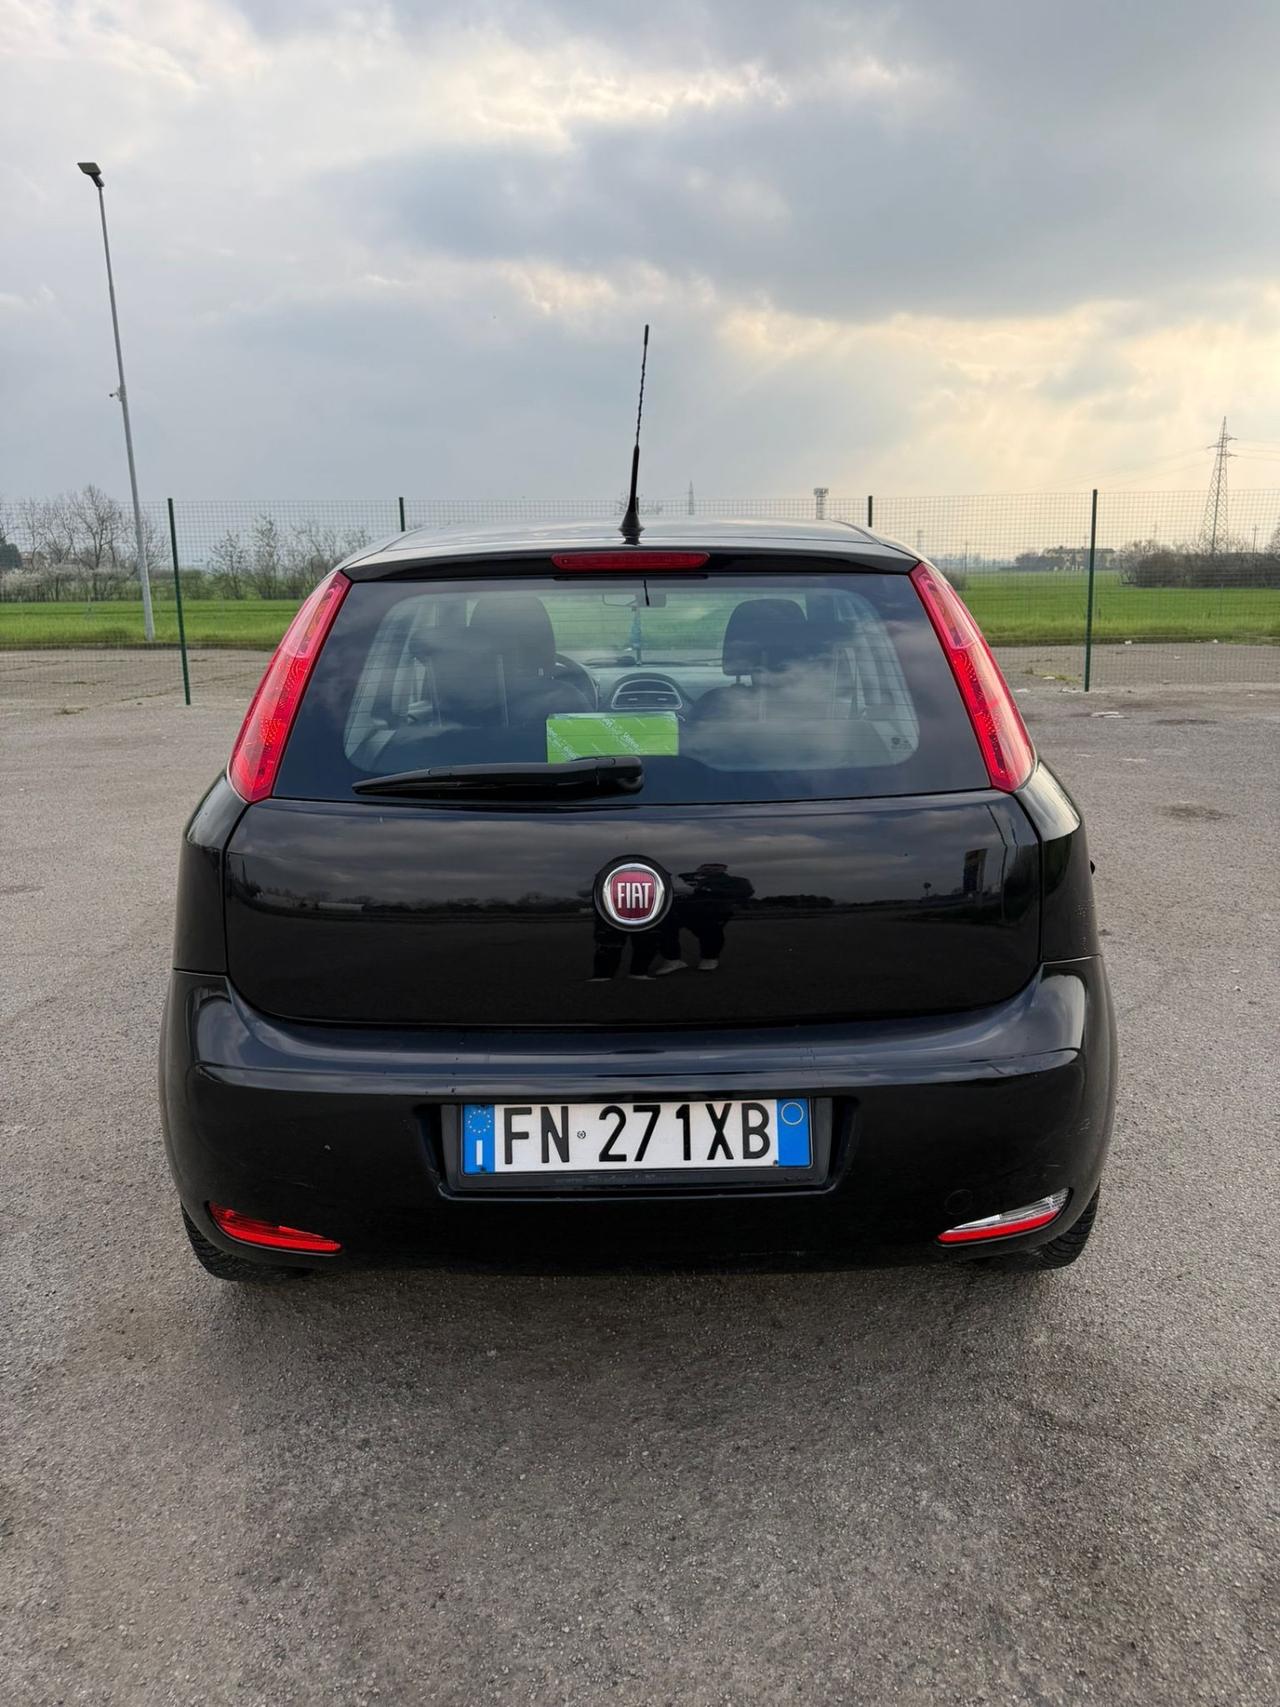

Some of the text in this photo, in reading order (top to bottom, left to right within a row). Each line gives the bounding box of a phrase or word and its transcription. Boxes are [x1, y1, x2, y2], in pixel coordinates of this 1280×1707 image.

[617, 882, 652, 909] FIAT
[503, 1102, 771, 1164] FN 271XB
[476, 1140, 483, 1165] I
